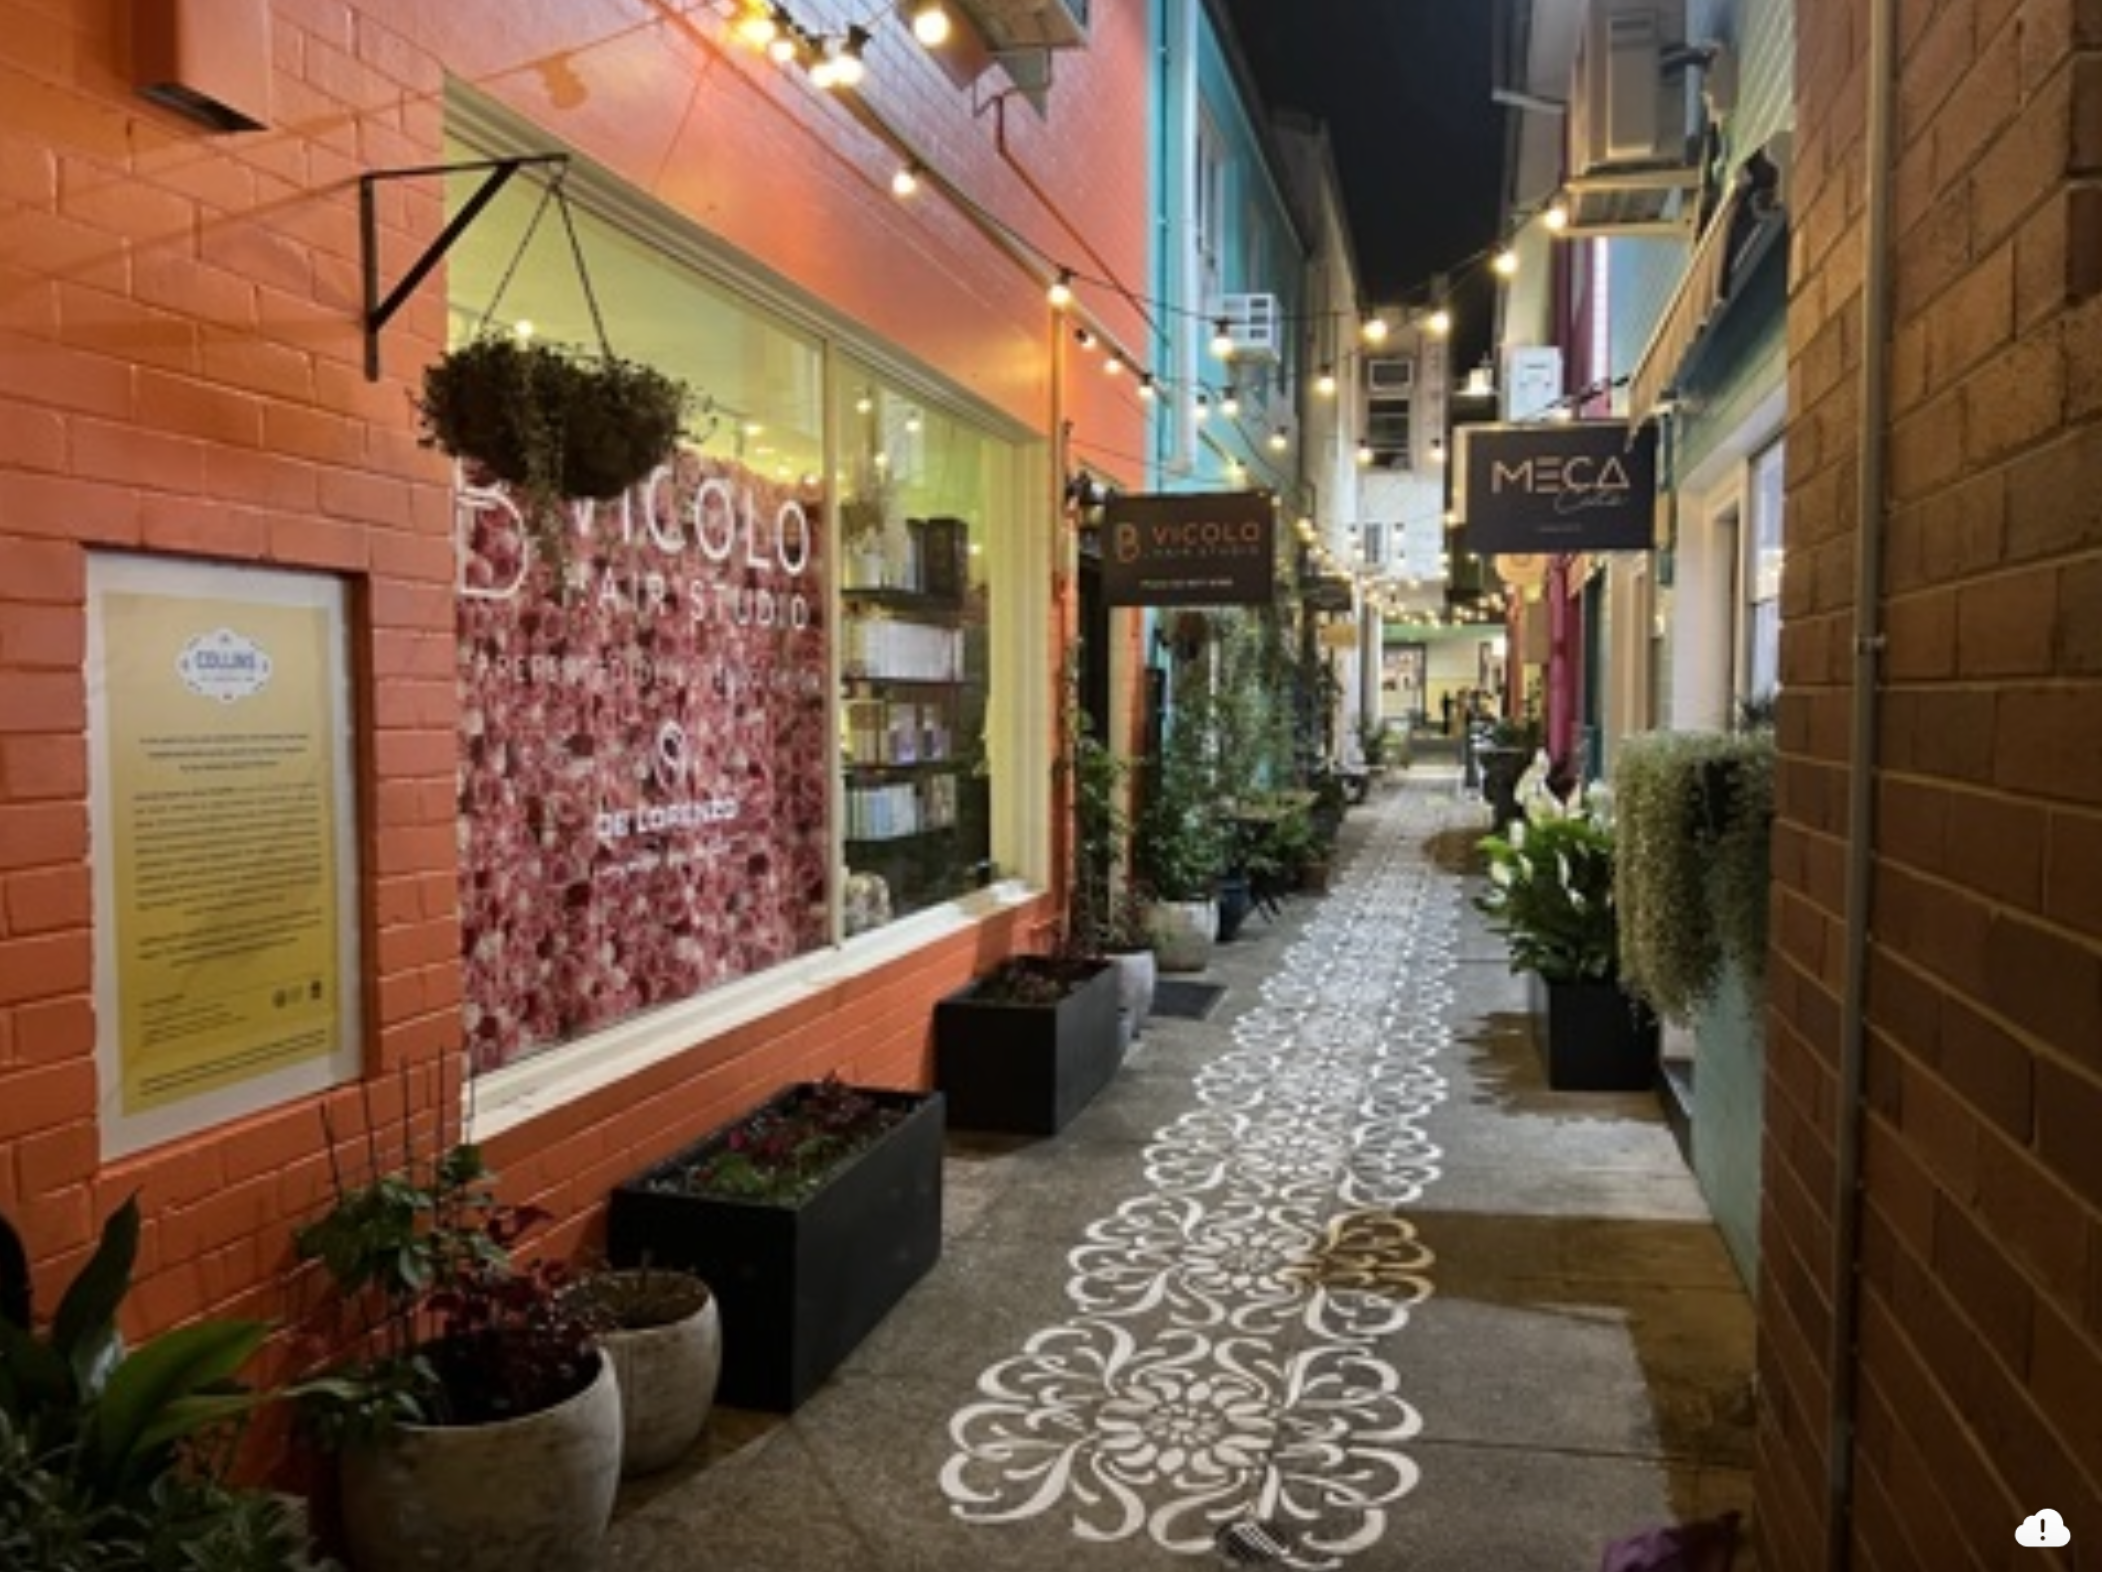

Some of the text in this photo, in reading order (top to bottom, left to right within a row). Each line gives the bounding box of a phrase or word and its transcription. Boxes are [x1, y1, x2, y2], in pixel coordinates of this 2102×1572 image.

[1491, 456, 1630, 493] MECA
[1152, 522, 1260, 546] VICOLO
[690, 579, 810, 629] STUDIO
